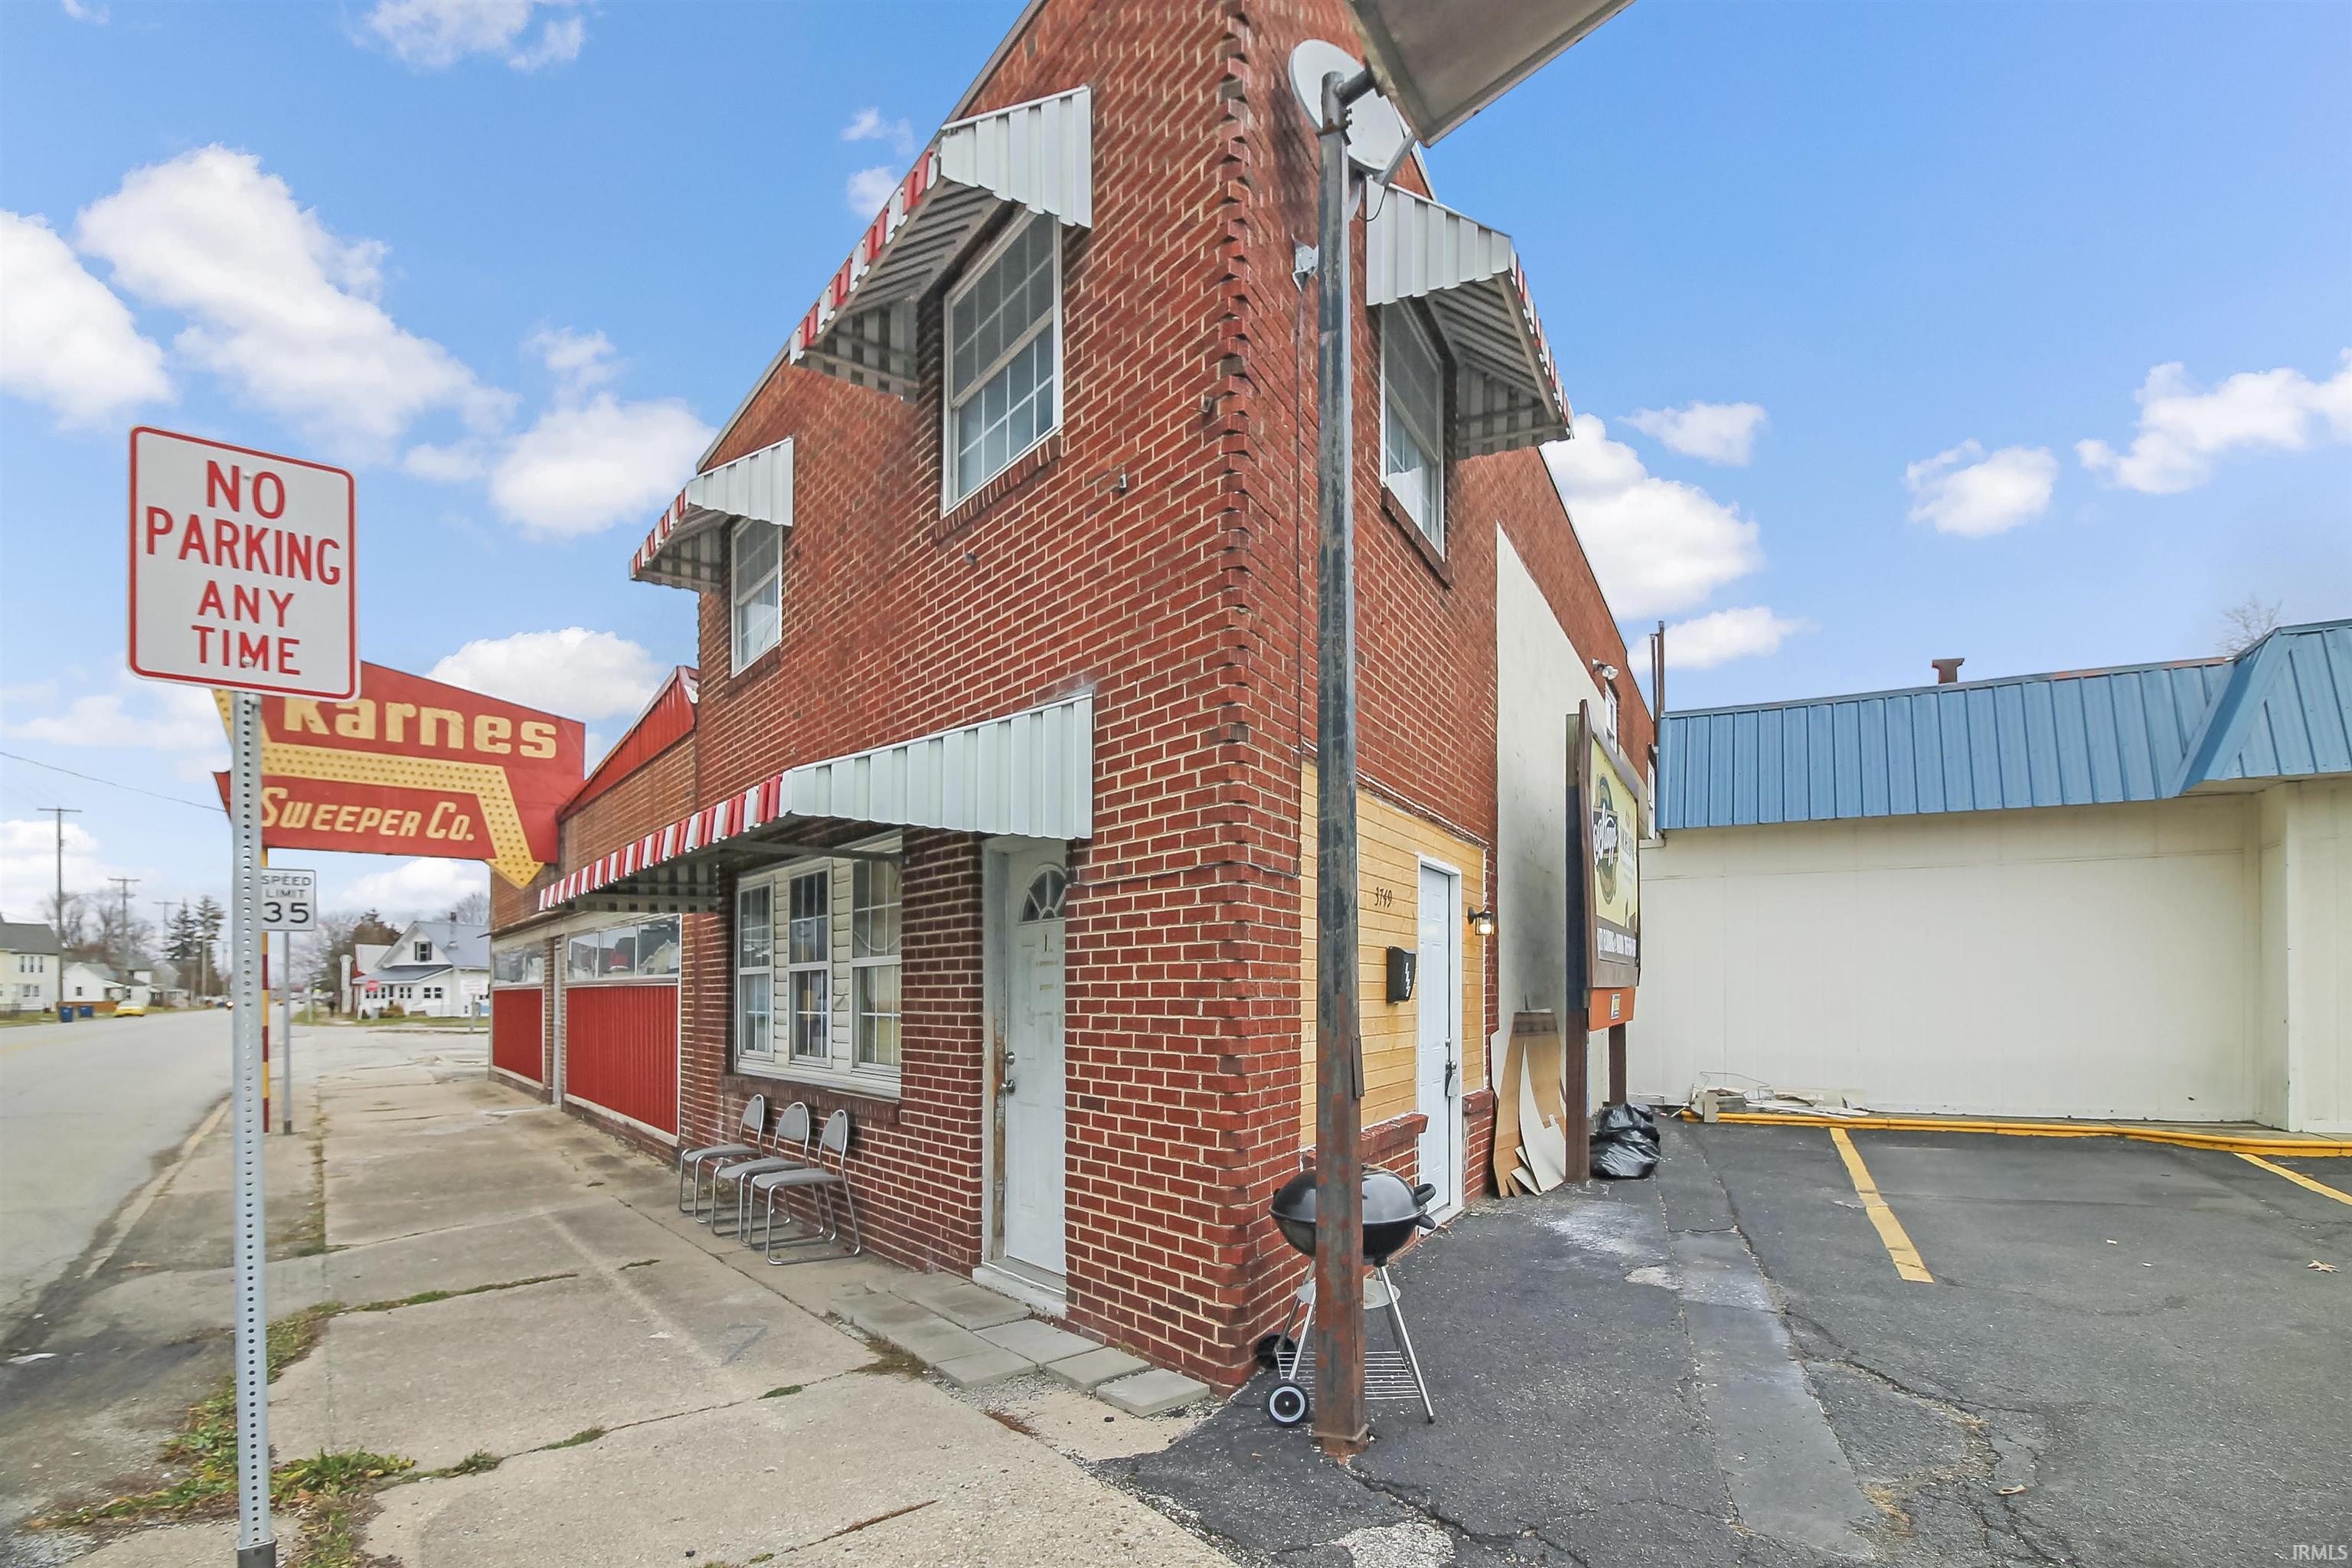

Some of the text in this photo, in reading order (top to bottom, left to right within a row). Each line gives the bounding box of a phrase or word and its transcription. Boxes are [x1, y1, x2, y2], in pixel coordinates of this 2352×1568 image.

[206, 460, 286, 519] NO
[145, 505, 341, 586] PARKING
[197, 580, 294, 628] ANY
[191, 624, 301, 675] TIME
[260, 875, 312, 887] SPEED
[265, 889, 306, 898] LIMIT
[263, 901, 309, 924] 35
